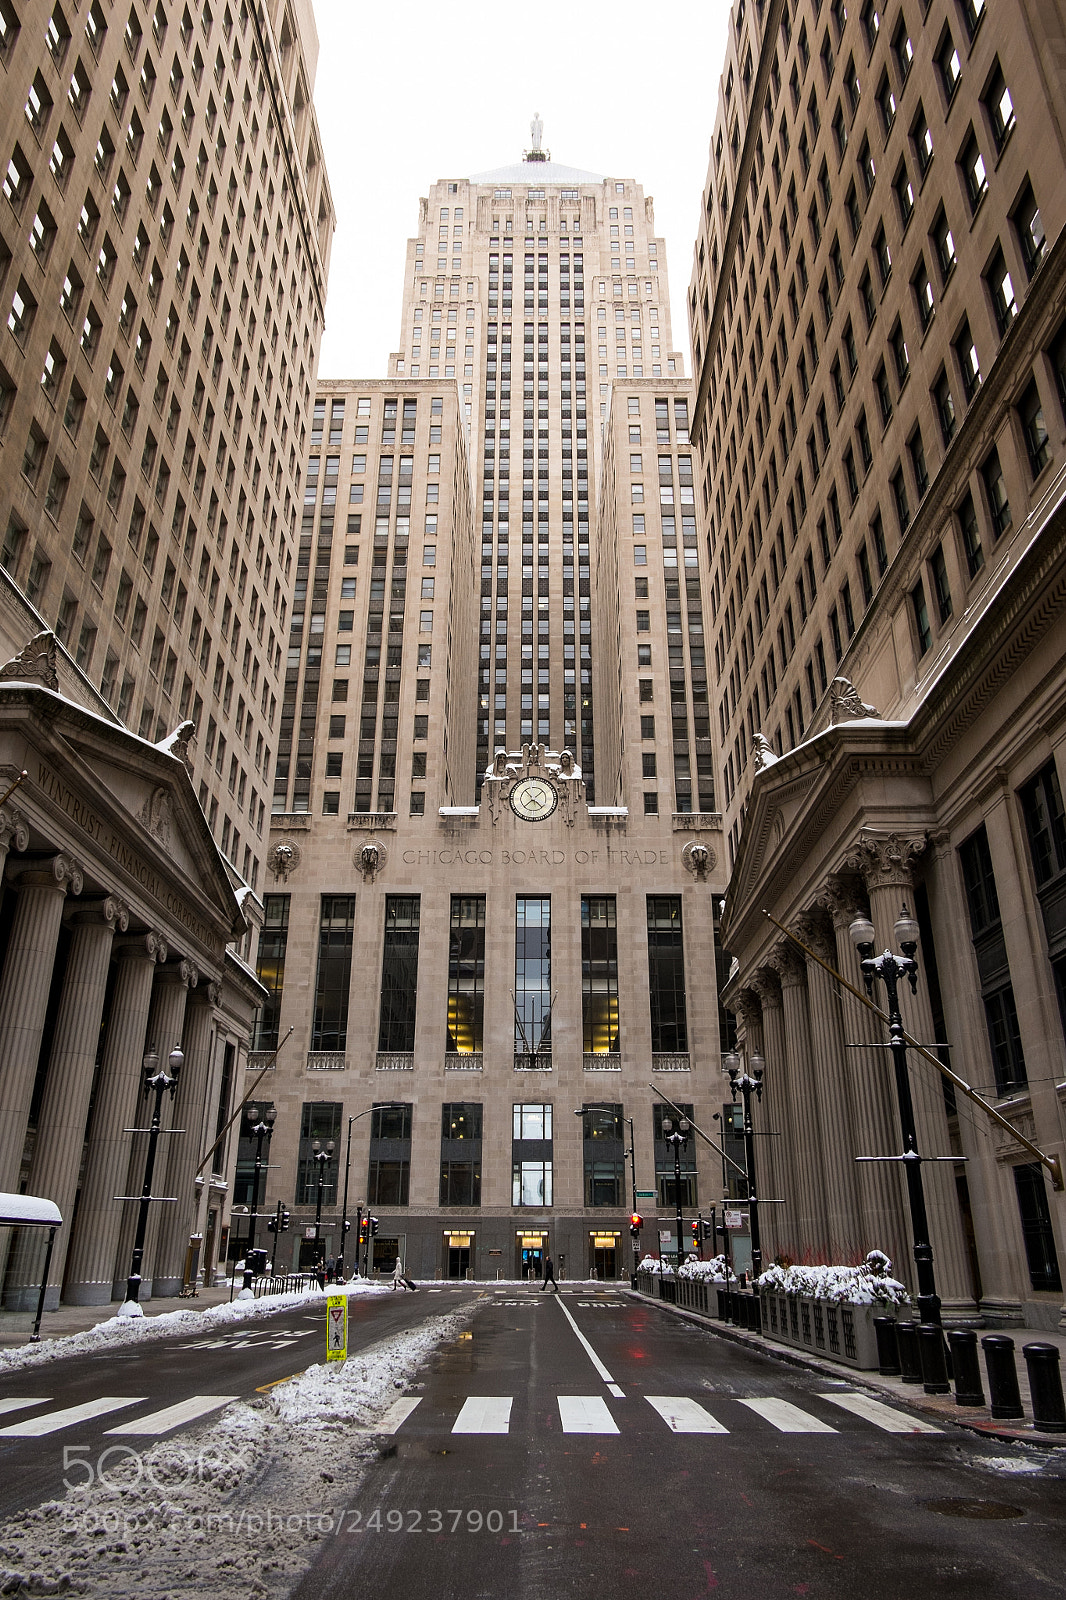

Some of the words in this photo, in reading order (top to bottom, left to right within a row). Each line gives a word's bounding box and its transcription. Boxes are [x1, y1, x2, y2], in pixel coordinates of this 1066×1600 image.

[38, 762, 104, 841] WINTRUST
[109, 836, 161, 899] FINANCIAL
[166, 893, 216, 951] CORPORATION
[402, 850, 493, 865] CHICAGO
[501, 850, 566, 865] BOARD
[574, 850, 599, 865] OF
[609, 850, 669, 865] TRADE
